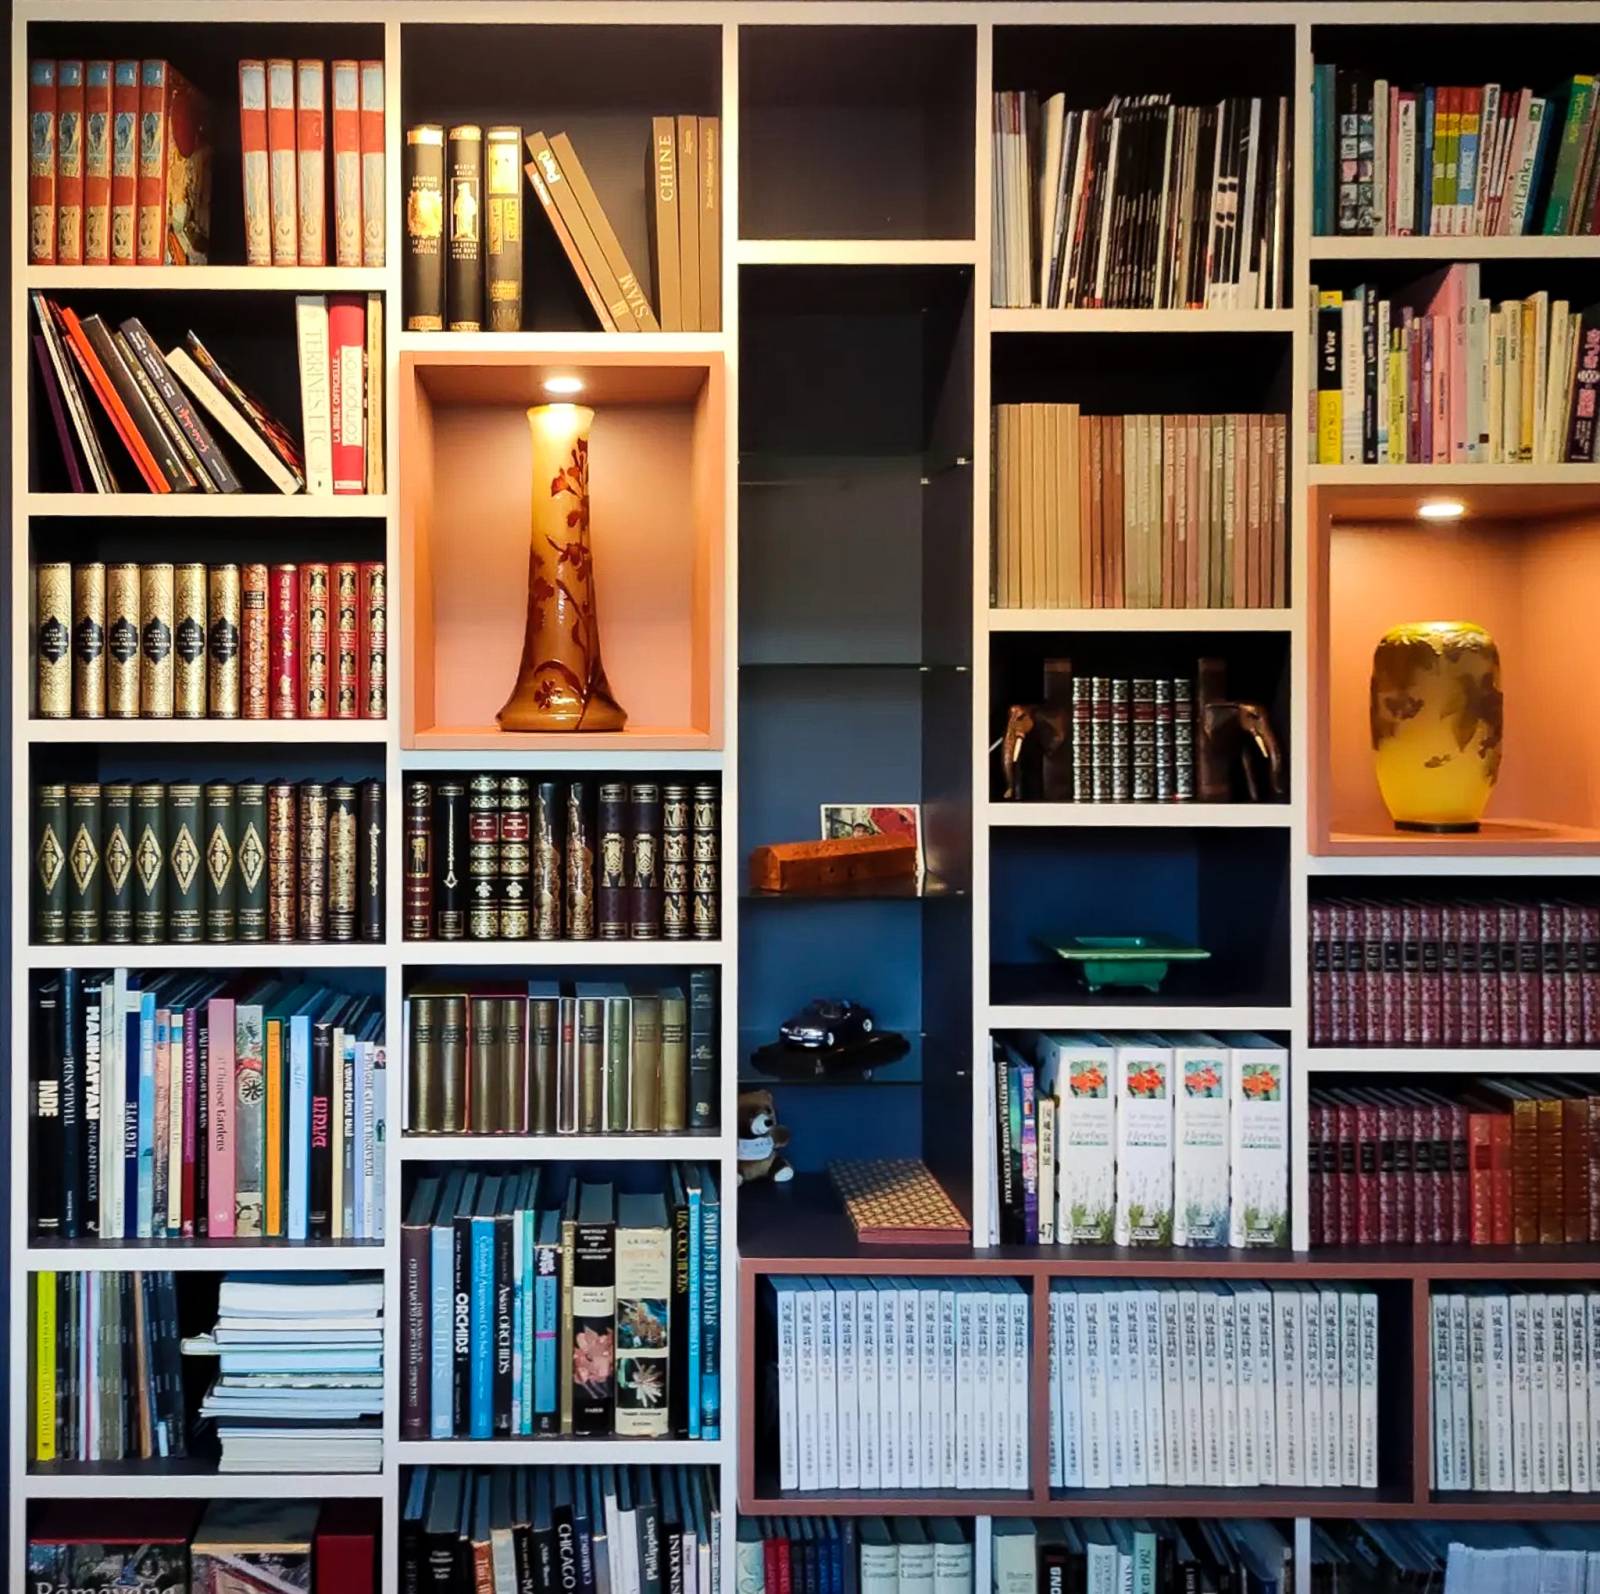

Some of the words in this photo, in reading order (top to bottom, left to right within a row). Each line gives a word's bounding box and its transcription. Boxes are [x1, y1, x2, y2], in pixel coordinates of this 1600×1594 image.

[658, 134, 674, 202] CHINE
[1515, 157, 1533, 198] Lanka
[1512, 199, 1525, 219] Sri
[618, 273, 650, 319] SIAM
[1324, 330, 1336, 354] Vue
[1324, 356, 1336, 372] La
[333, 431, 341, 443] LA
[86, 1006, 100, 1120] MANHATTAN
[185, 1047, 194, 1083] KYOTO
[38, 1080, 59, 1118] INDE
[216, 1109, 228, 1152] Gardens
[499, 1283, 511, 1314] Asian
[435, 1284, 448, 1378] ORCHIDS
[455, 1293, 469, 1354] ORCHIDS
[499, 1315, 511, 1374] ORCHIDS
[558, 1523, 576, 1589] CHICAGO
